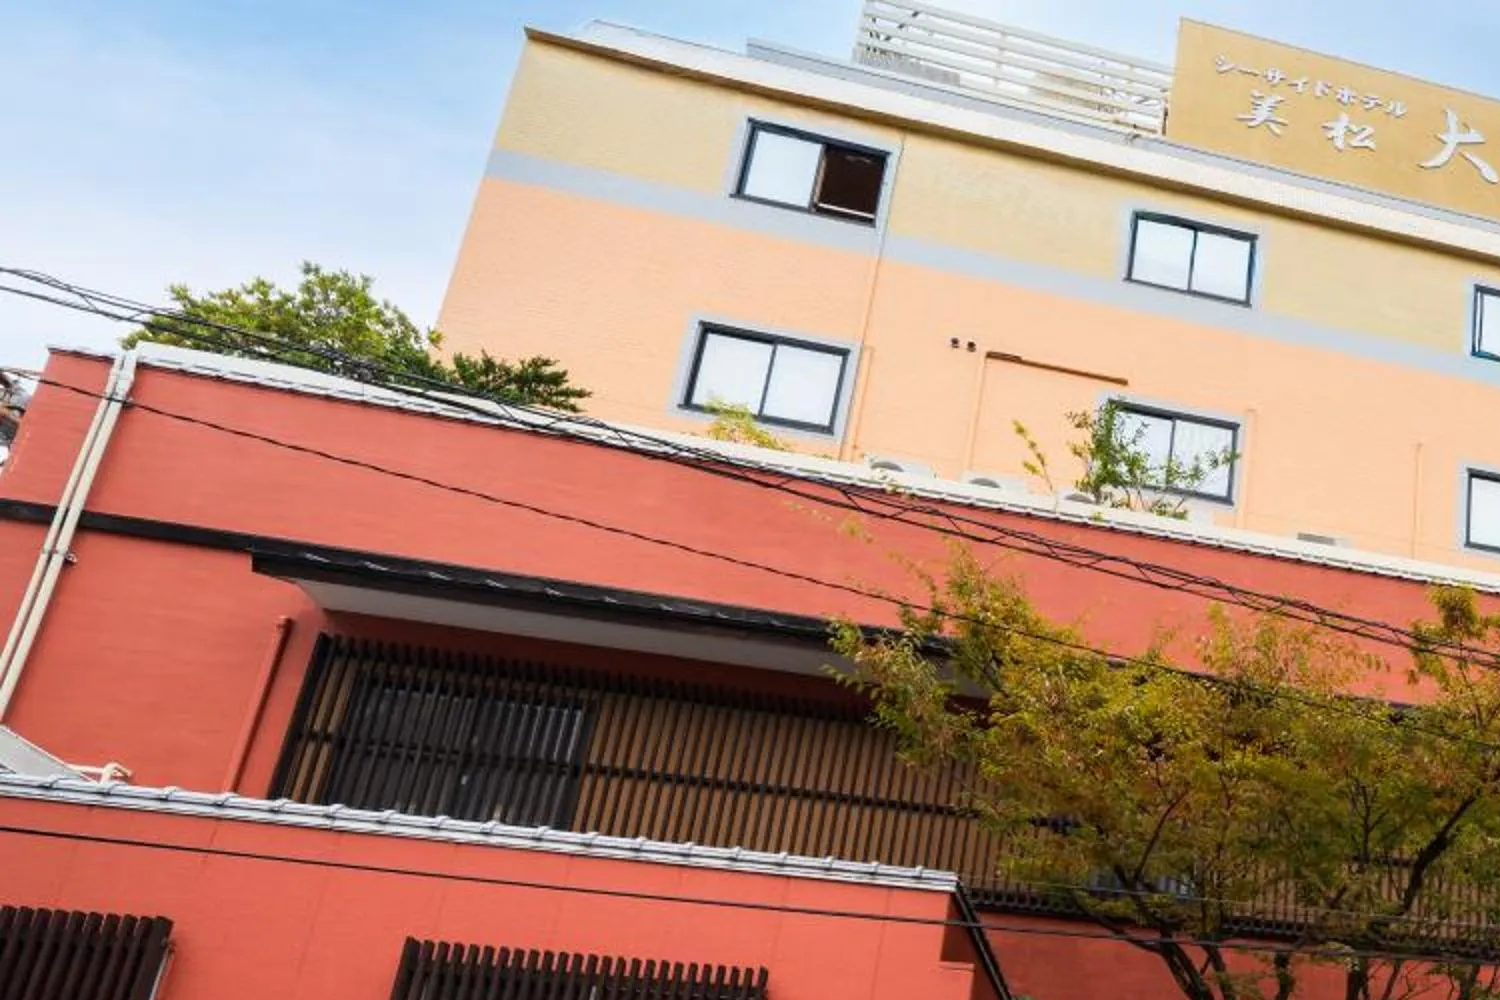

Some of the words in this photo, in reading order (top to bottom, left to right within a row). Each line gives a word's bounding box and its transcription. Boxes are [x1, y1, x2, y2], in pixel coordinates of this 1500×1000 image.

[1213, 53, 1409, 120] シーサイドホテル
